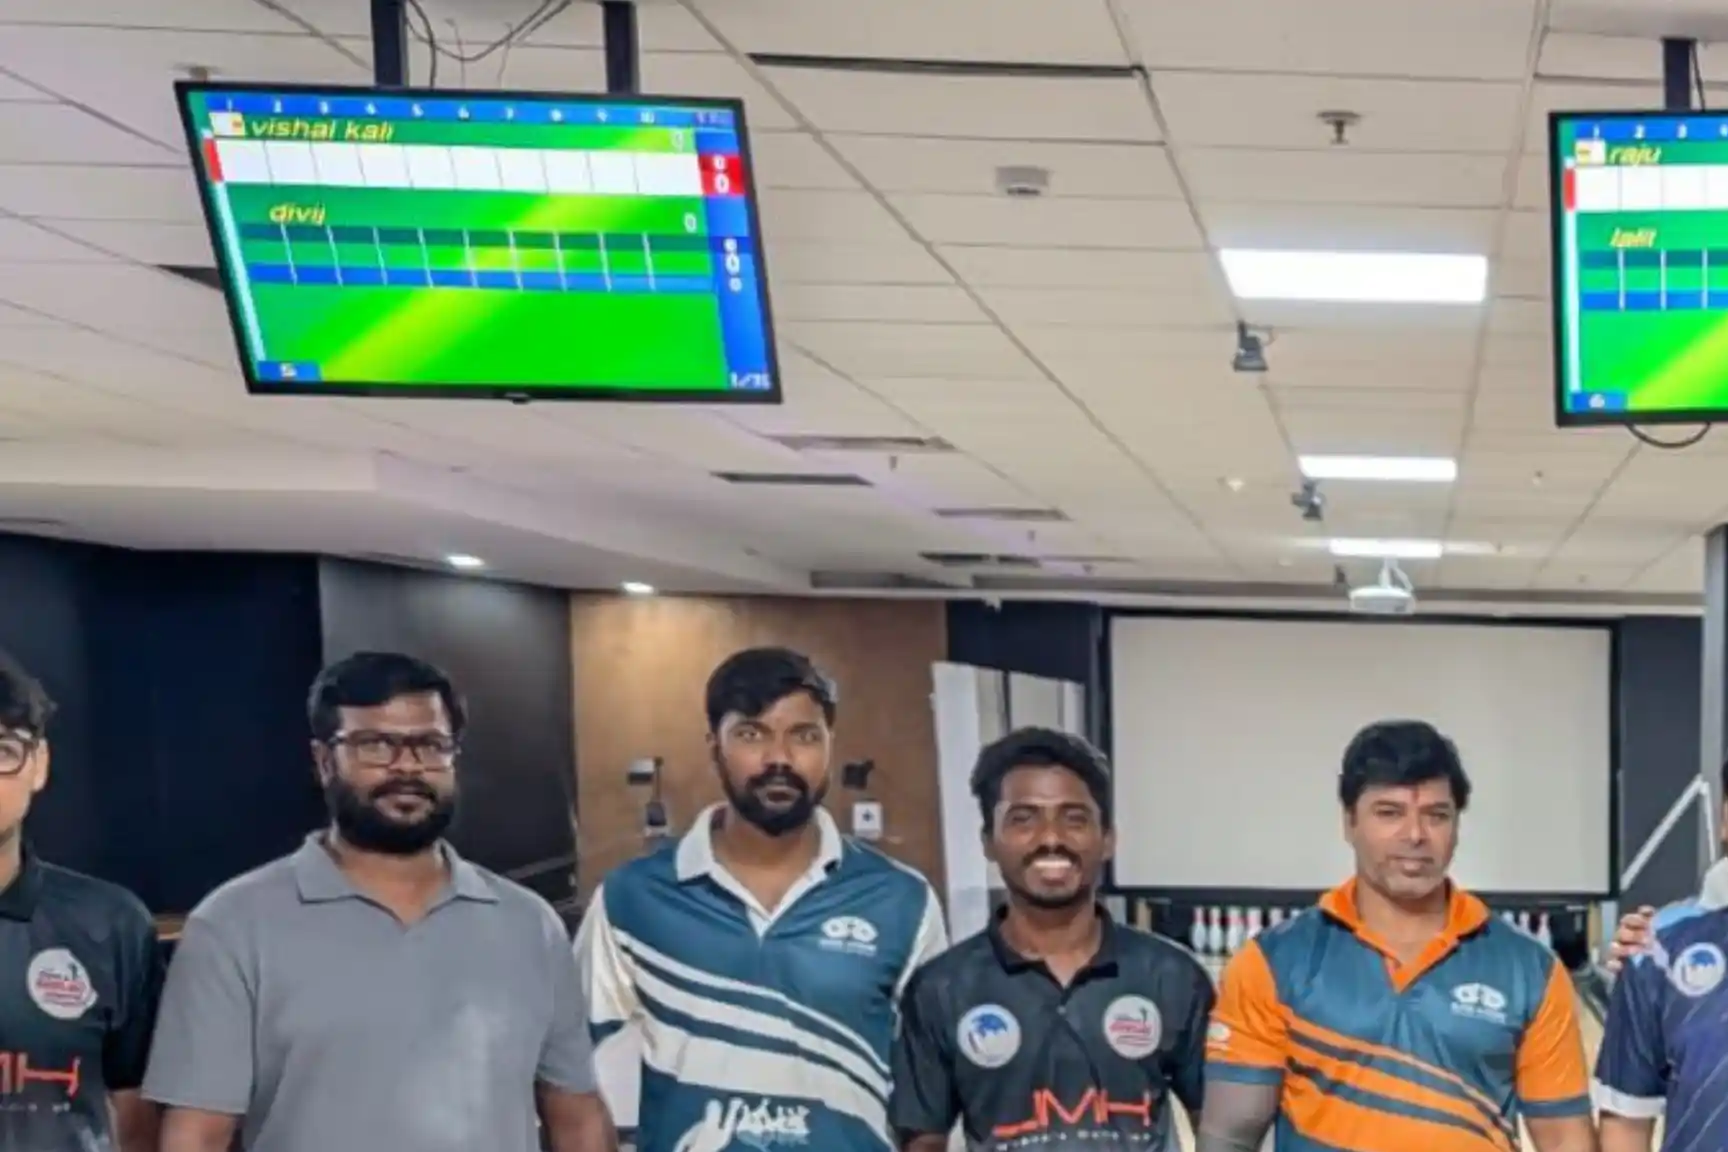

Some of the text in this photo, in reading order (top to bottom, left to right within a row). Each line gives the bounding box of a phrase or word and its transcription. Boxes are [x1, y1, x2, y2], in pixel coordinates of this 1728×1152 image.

[250, 118, 395, 143] vishal kali
[992, 1085, 1152, 1137] JMH
